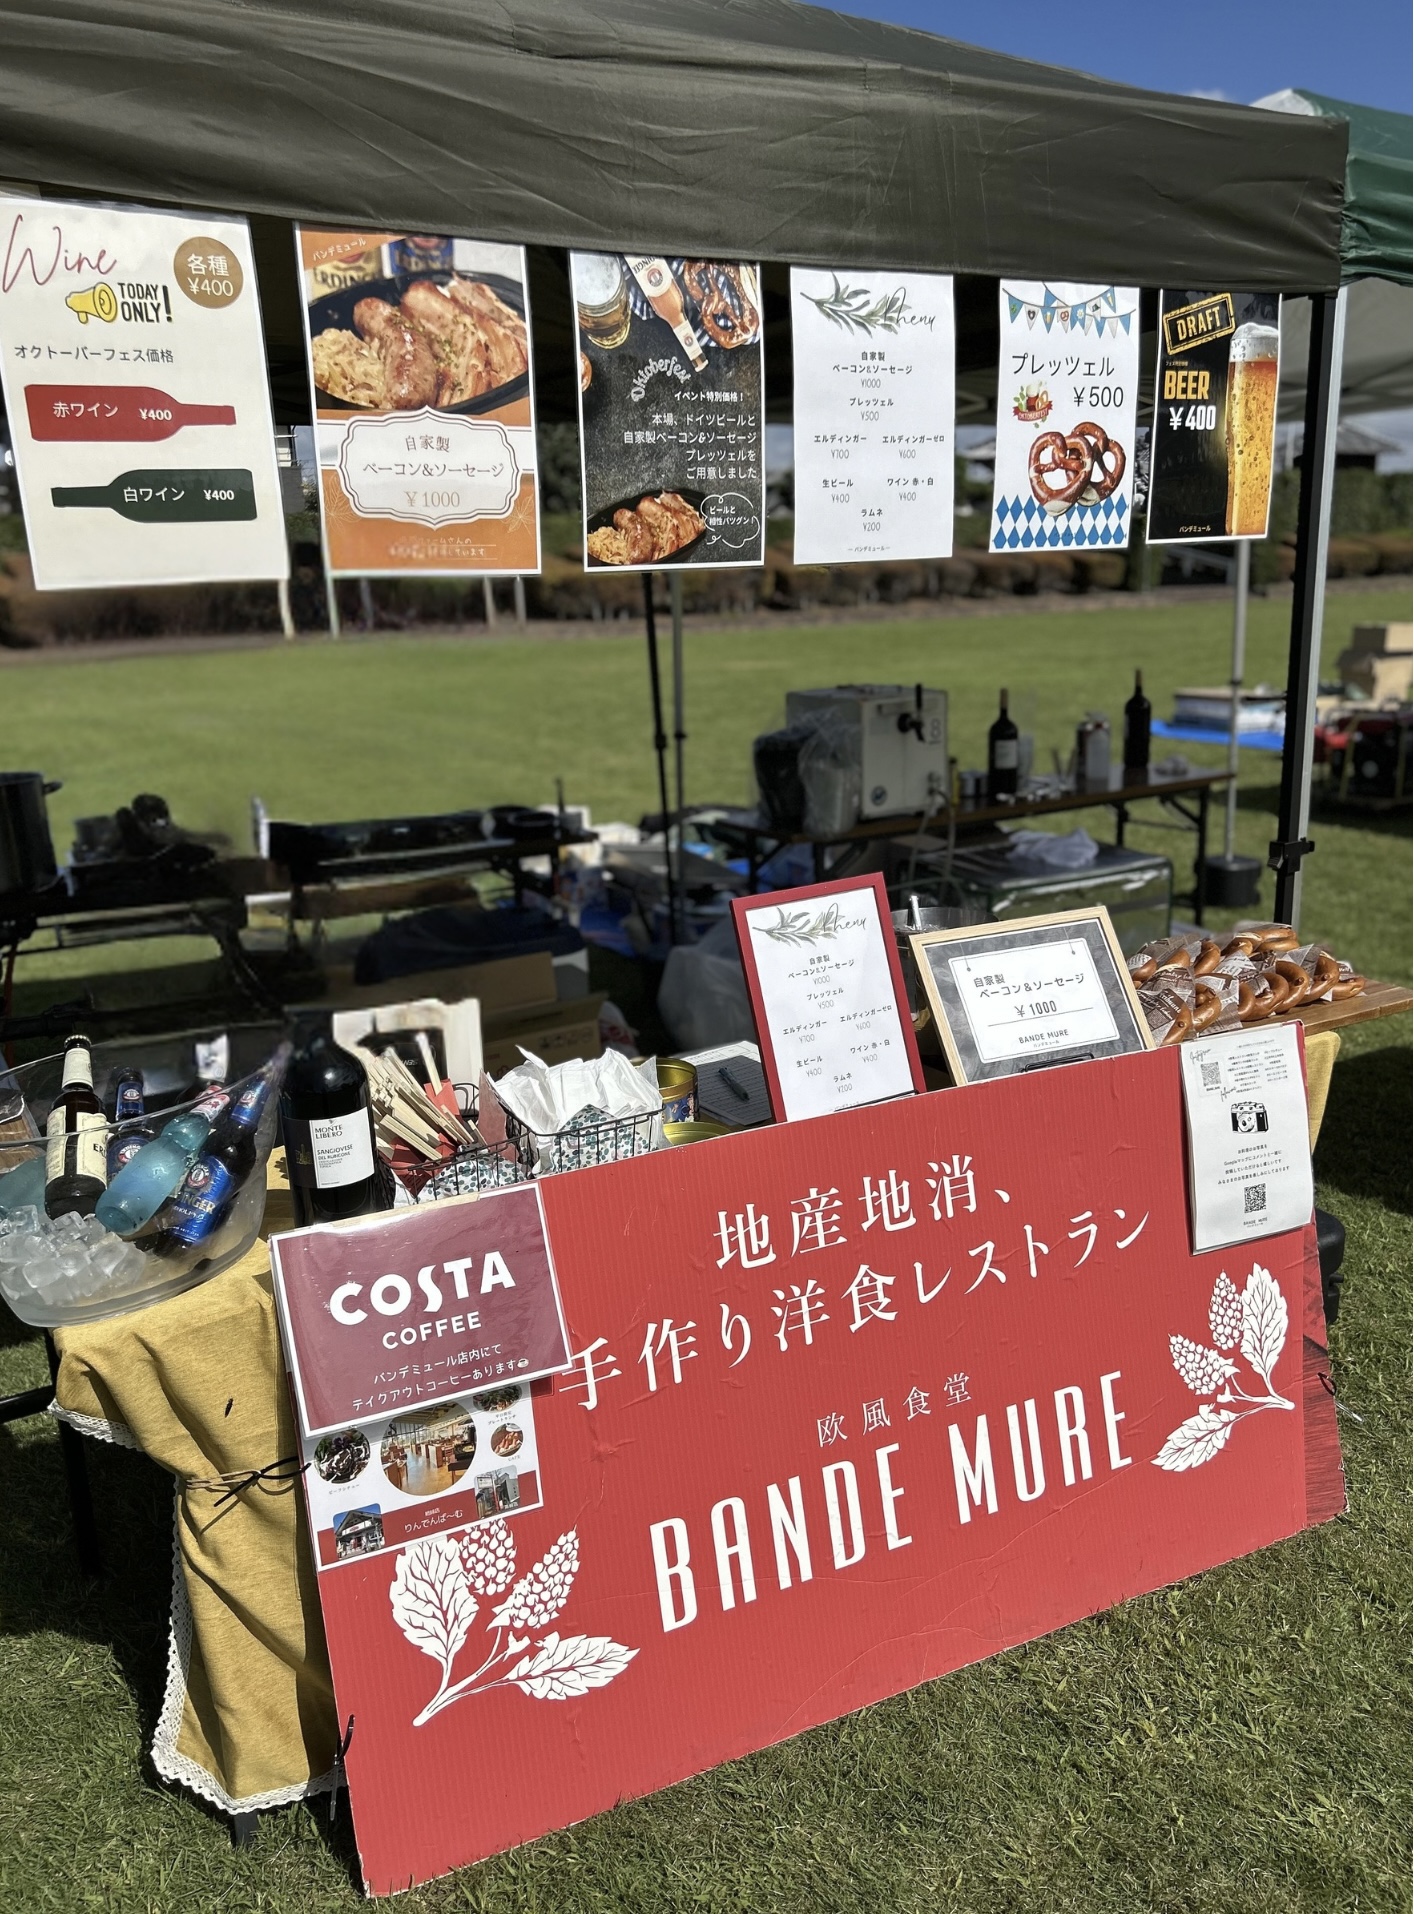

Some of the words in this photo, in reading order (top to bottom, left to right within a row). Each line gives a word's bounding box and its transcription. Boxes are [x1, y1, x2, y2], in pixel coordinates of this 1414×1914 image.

[2, 214, 117, 293] Wine
[187, 253, 229, 277] 各種
[118, 282, 160, 300] TODAY
[188, 277, 233, 297] ¥400
[1177, 306, 1222, 341] DRAFT
[14, 344, 174, 364] オクトーバーフェス価格
[861, 351, 886, 362] 自家製
[833, 364, 913, 375] ベーコン&ソーセージ
[1012, 353, 1115, 377] プレッツェル
[861, 378, 881, 389] ¥1000
[1164, 370, 1210, 400] BEER
[850, 397, 894, 407] プレッツェル
[1073, 386, 1124, 408] ¥500
[53, 401, 119, 419] 赤ワイン
[140, 408, 172, 421] ¥400
[861, 411, 880, 422] ¥500
[1169, 405, 1216, 431] ¥400
[651, 413, 756, 427] 本場、ドイツビールと
[405, 435, 450, 453] 自家製
[624, 431, 757, 444] 自家製ベーコン&ソーセージ
[814, 434, 867, 444] エルディンガー
[882, 434, 945, 444] エルディンガーゼロ
[686, 450, 757, 462] プレッツェルを
[831, 449, 849, 460] ¥700
[363, 462, 505, 478] ベーコン&ソーセージ
[686, 466, 757, 480] ご用意しました
[822, 478, 854, 488] 生ビール
[123, 486, 185, 503] 白ワイン
[204, 488, 235, 501] ¥400
[404, 491, 460, 508] ¥1000
[831, 493, 850, 503] ¥400
[899, 491, 916, 502] ¥400
[710, 505, 735, 514] ビールと
[861, 508, 883, 518] ラムネ
[862, 522, 881, 532] ¥200
[973, 974, 1005, 988] 自家製
[979, 973, 1084, 998] ベーコン＆ソーセージ
[807, 988, 844, 1001] プレッツェル
[783, 1020, 827, 1035] エルディンガー
[1018, 1032, 1045, 1043] BANDE
[1047, 1029, 1069, 1039] MURE
[796, 1056, 823, 1068] 生ビール
[833, 1072, 853, 1083] ラムネ
[315, 1124, 343, 1134] MONTE
[315, 1131, 343, 1139] LIBERO
[317, 1144, 353, 1155] SANGIOVESE
[713, 1154, 1012, 1271] 地産地消、
[329, 1251, 516, 1326] COSTA
[558, 1209, 1151, 1410] 手作り洋食レストラン
[382, 1311, 482, 1350] COFFEE
[374, 1344, 501, 1384] バンデミュール店内にて
[352, 1360, 517, 1411] テイクアウトコーヒーあります
[816, 1372, 972, 1449] 欧風食堂
[650, 1442, 912, 1633] BANDE
[948, 1370, 1132, 1524] MURE
